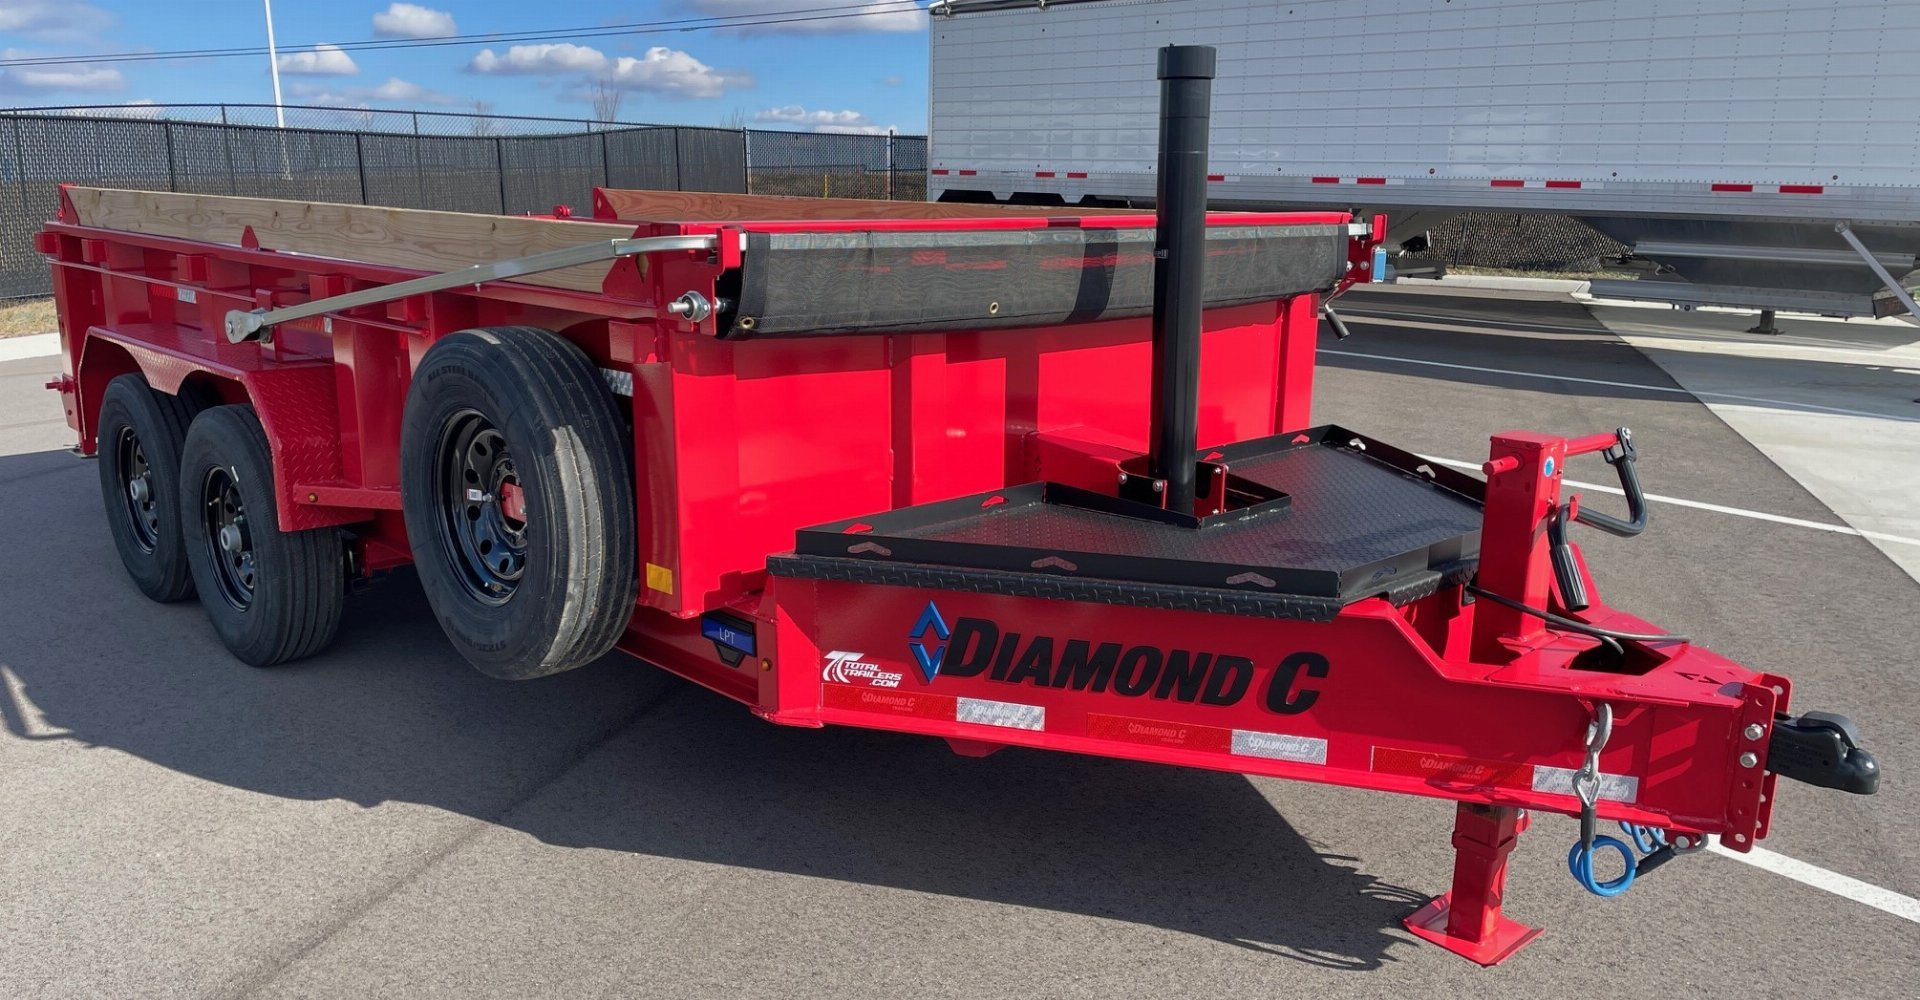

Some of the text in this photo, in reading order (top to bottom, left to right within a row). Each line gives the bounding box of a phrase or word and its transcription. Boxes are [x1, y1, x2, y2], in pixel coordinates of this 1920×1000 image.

[719, 627, 736, 645] LPT
[844, 661, 881, 672] TOTAL
[942, 616, 1330, 715] DIAMOND C
[844, 668, 903, 681] TRAILERS
[868, 679, 899, 688] .COM
[907, 697, 916, 707] C
[1135, 724, 1188, 739] DIAMOND C
